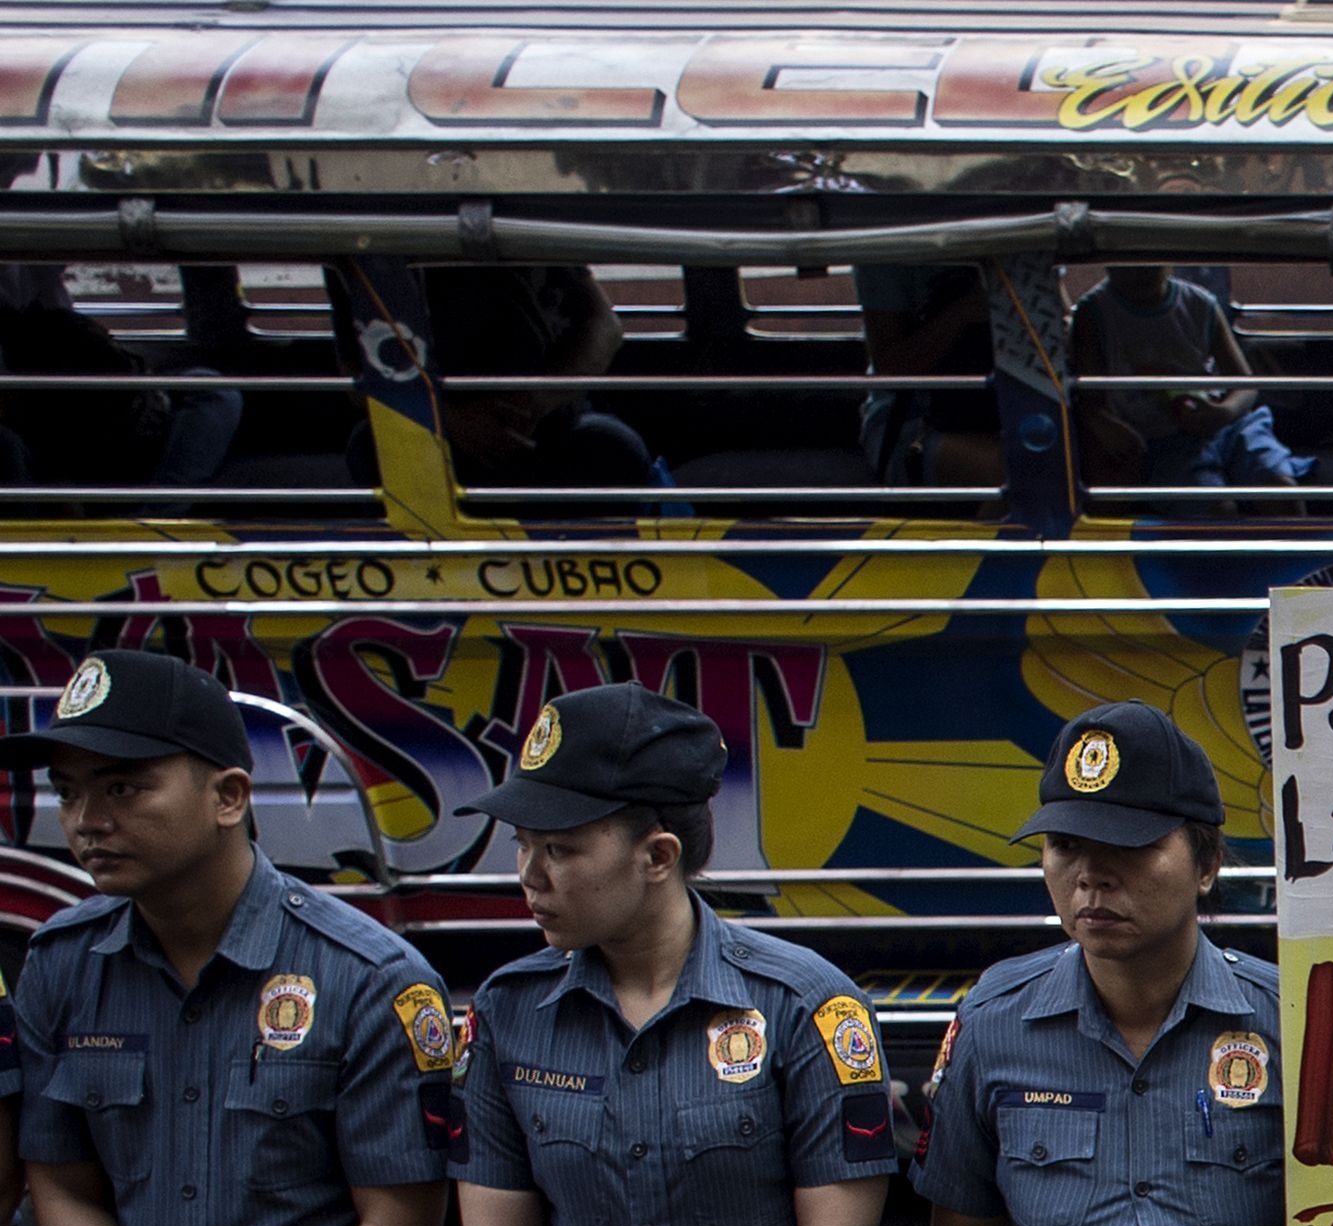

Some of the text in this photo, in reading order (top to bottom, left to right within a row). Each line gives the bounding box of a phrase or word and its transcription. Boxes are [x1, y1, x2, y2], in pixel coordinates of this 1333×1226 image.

[195, 557, 663, 598] COGEO CUBAO
[514, 1066, 587, 1092] DULNUAN
[1023, 1091, 1073, 1105] UMPAD
